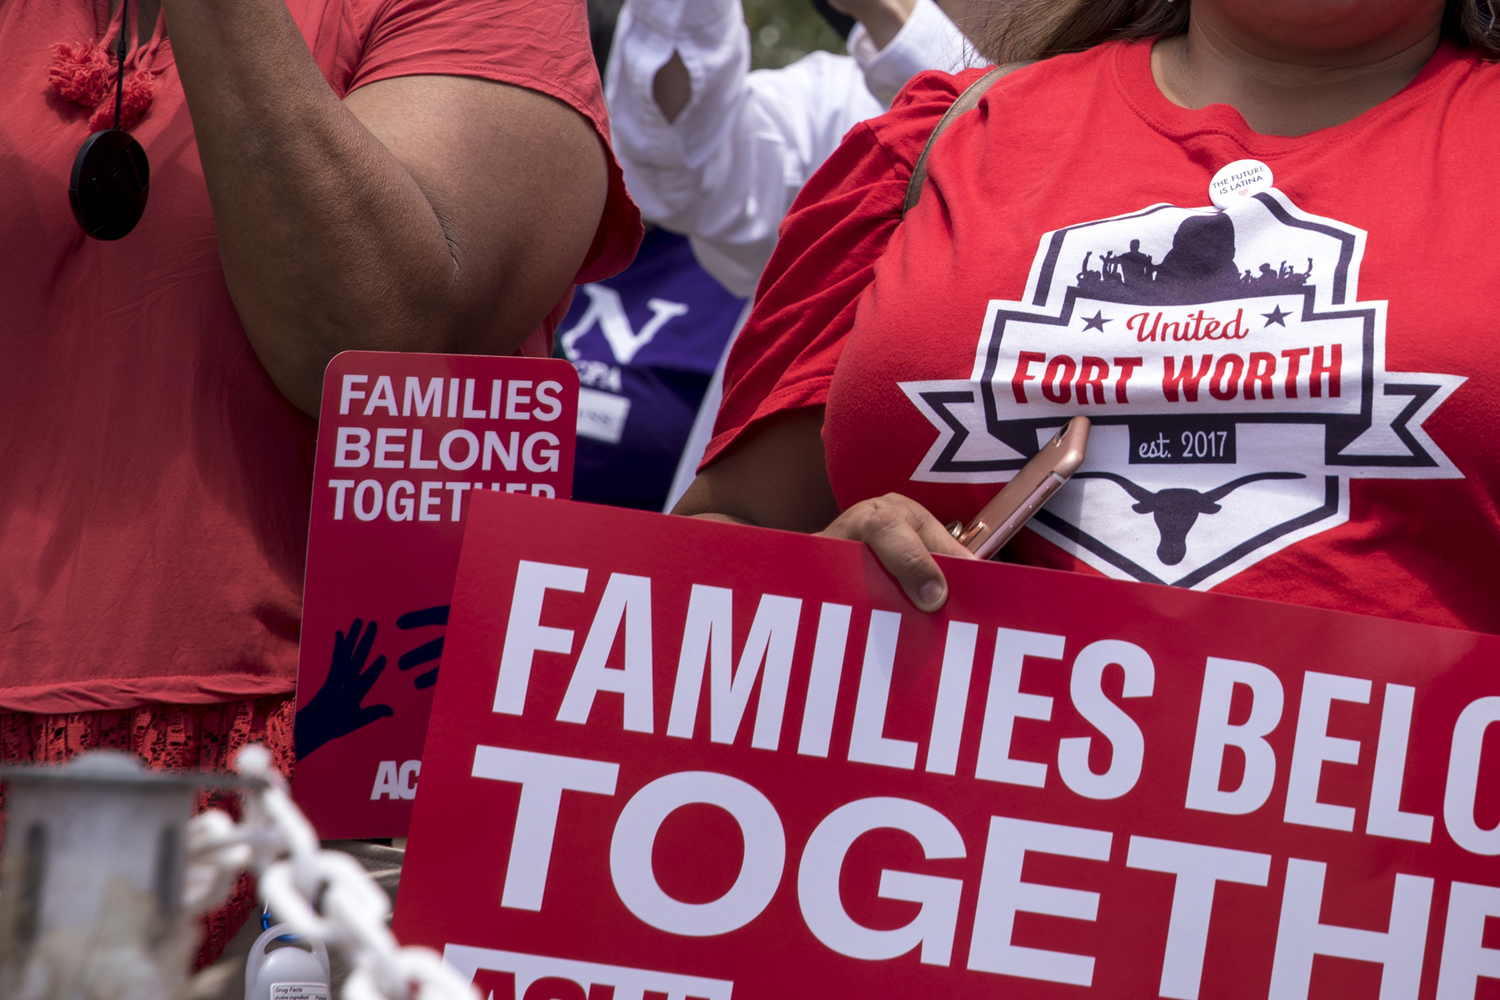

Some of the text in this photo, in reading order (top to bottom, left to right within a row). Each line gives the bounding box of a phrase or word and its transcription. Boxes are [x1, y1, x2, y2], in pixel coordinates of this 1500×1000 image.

[1212, 165, 1265, 189] THE FUTURE
[1219, 175, 1263, 195] IS LATINA
[560, 282, 690, 365] N
[1126, 308, 1250, 343] United
[1012, 343, 1343, 405] FORT WORTH
[339, 374, 564, 421] FAMILIES
[334, 427, 561, 472] BELONG
[1138, 430, 1227, 460] est. 2017
[328, 479, 556, 522] TOGET
[492, 559, 1156, 800] FAMILIES
[370, 759, 421, 800] AC
